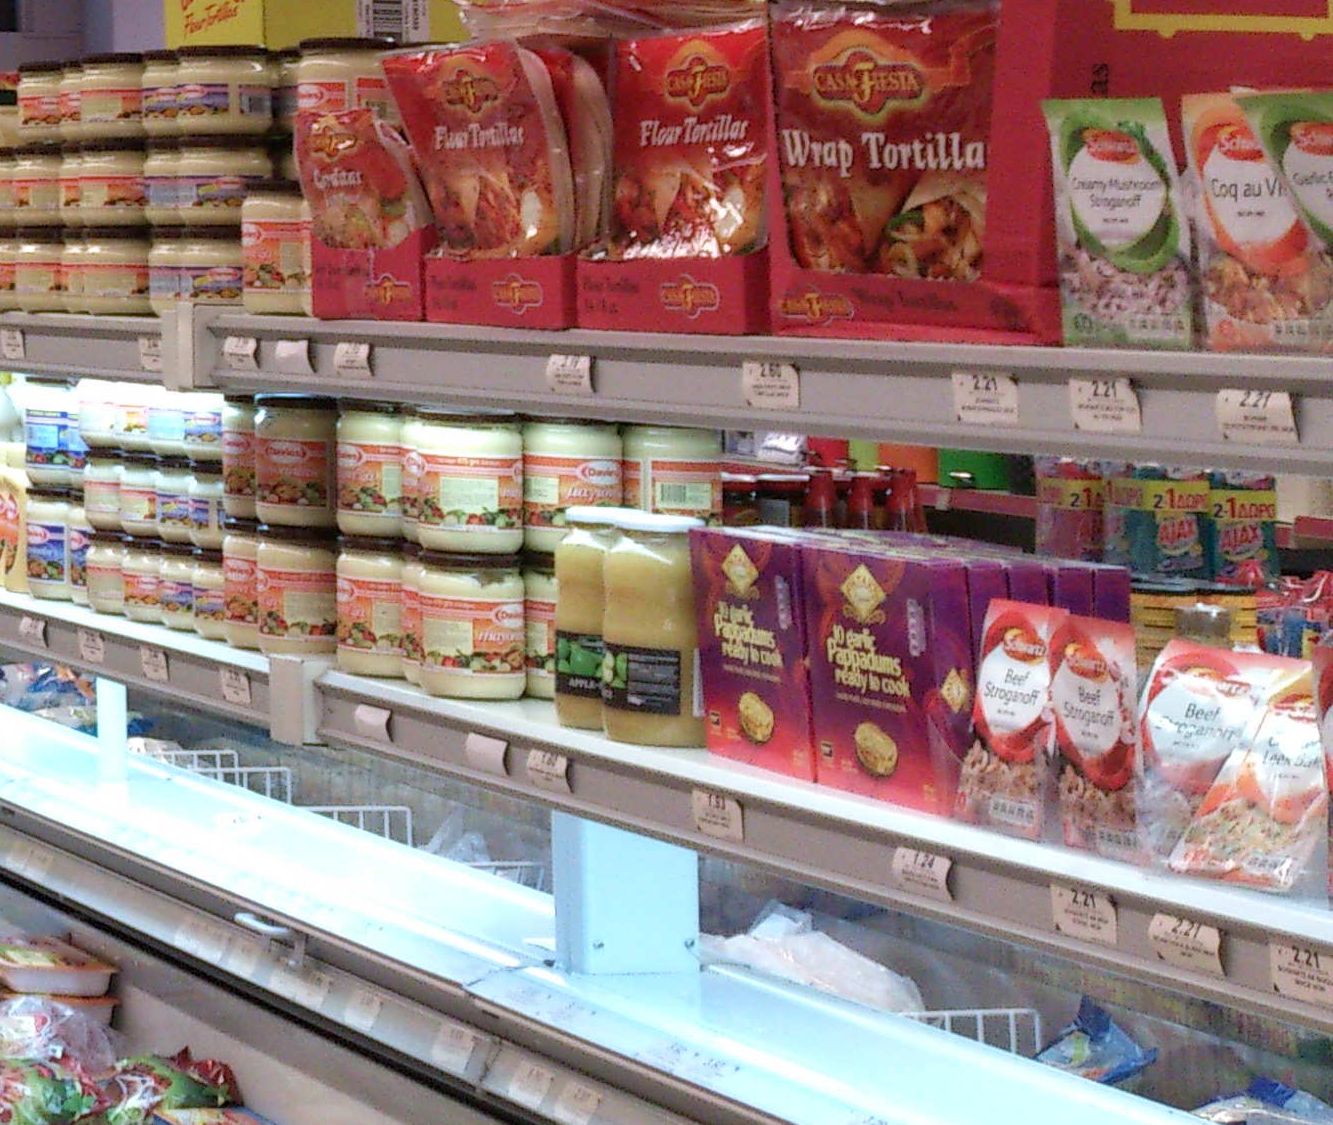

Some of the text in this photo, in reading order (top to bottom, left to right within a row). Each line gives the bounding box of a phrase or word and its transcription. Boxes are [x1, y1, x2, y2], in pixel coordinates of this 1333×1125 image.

[640, 114, 748, 146] Flour Tortillas
[784, 130, 985, 178] Wrap Tortilla
[1090, 194, 1141, 210] Stroganoff
[1212, 179, 1237, 201] Coq
[1243, 181, 1261, 197] au
[1159, 516, 1195, 544] AJAX
[1220, 524, 1258, 552] AJAX
[827, 637, 901, 676] Pappadums
[835, 669, 866, 694] ready
[881, 678, 910, 697] cook
[1005, 668, 1030, 686] Beef
[985, 682, 1041, 706] Stroganoff
[1078, 686, 1101, 704] Beef
[1064, 702, 1114, 726] Stroganoff
[1185, 703, 1221, 722] Beef
